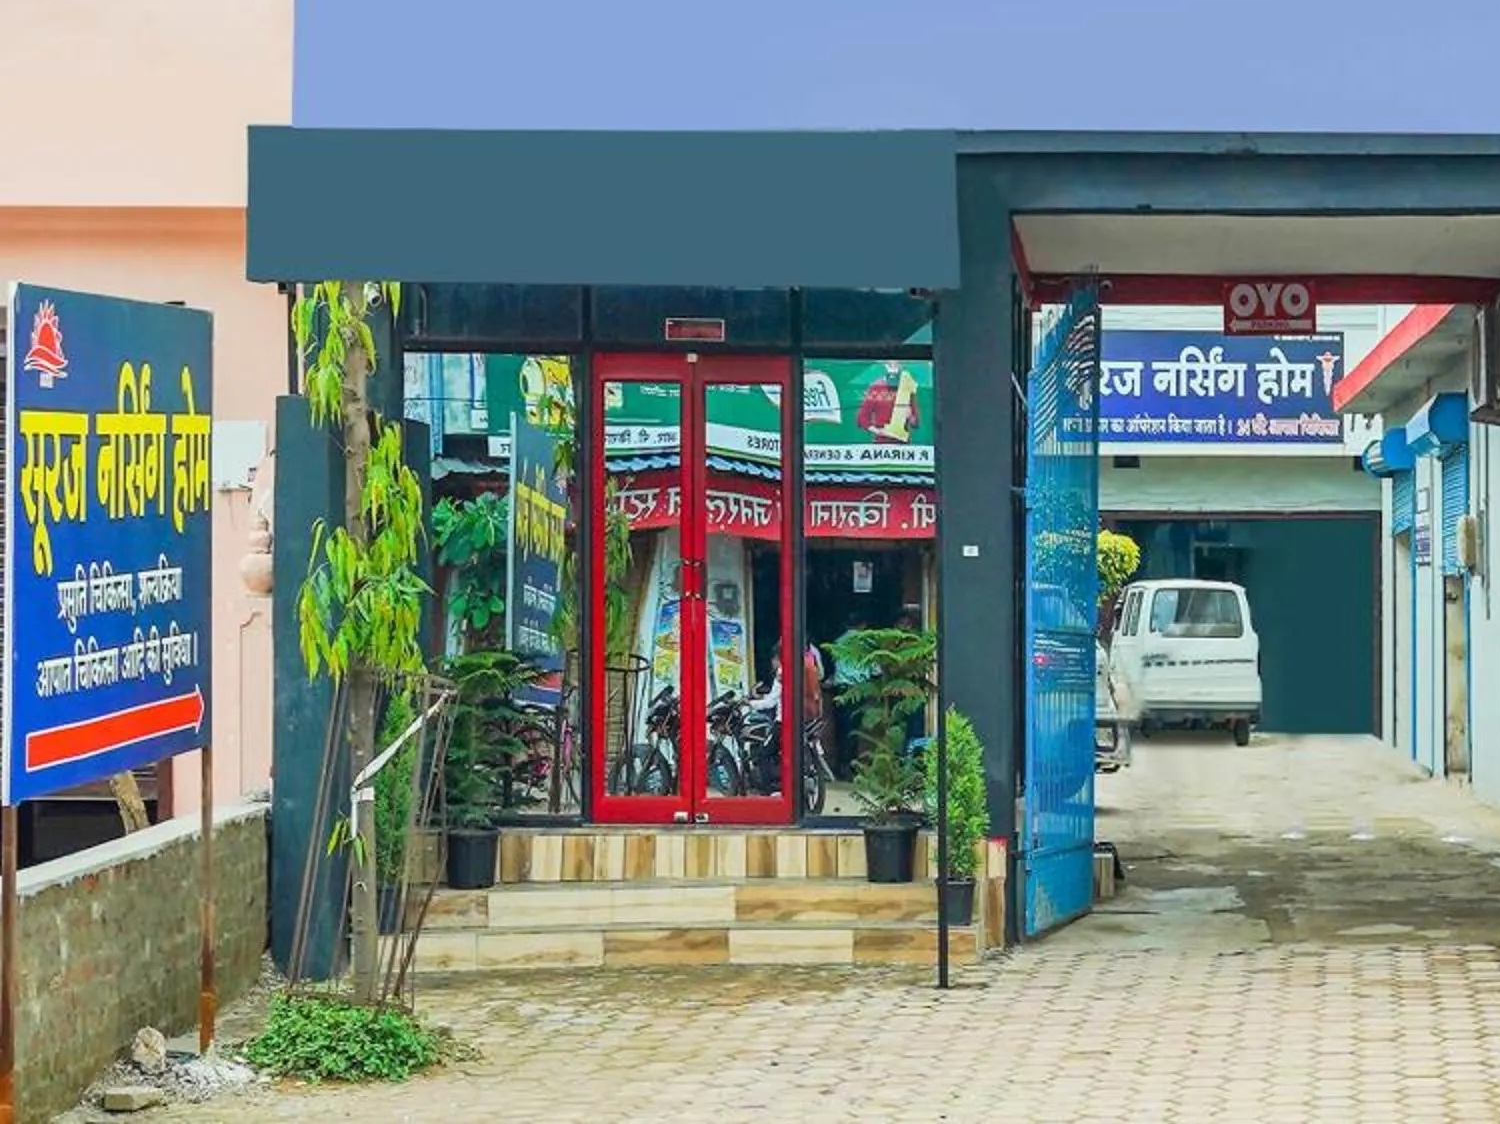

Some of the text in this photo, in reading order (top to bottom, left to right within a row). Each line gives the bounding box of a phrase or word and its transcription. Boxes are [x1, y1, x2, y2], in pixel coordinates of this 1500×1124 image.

[1229, 282, 1310, 317] OYO
[1098, 360, 1145, 397] रज
[1255, 347, 1315, 404] होम
[20, 410, 89, 576] सूरज
[172, 366, 211, 534] होम
